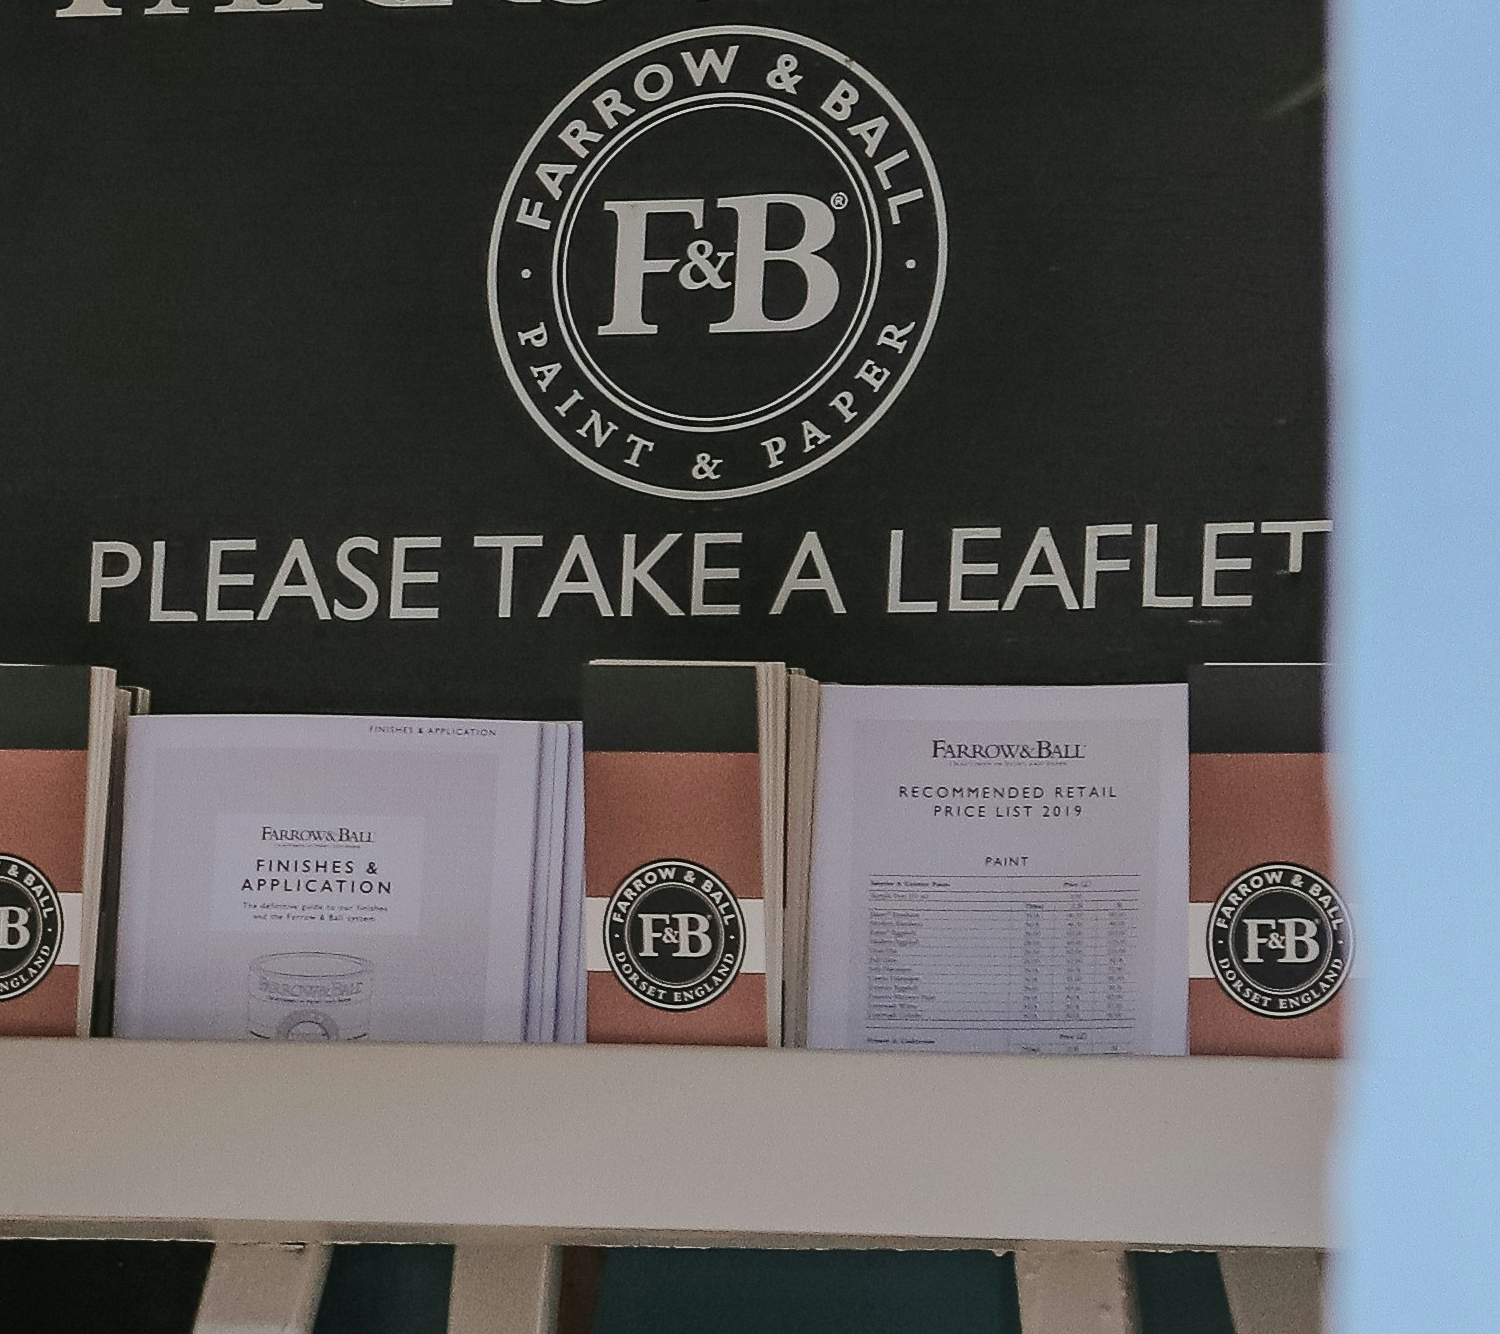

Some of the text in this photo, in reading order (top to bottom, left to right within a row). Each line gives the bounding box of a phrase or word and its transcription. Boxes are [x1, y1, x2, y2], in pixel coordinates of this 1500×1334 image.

[516, 45, 924, 229] FARROW & BALL
[518, 321, 915, 480] PAINT & PAPER
[89, 519, 1335, 622] PLEASE TAKE A LEAFLET
[427, 727, 497, 736] APPLICATION
[899, 785, 1118, 799] RECOMMENDED RETAIL
[933, 805, 1083, 818] PRICE LIST 2019
[240, 878, 392, 894] APPLICATION
[256, 859, 378, 875] FINISHES &
[985, 856, 1030, 867] PAINT
[7, 864, 20, 878] &
[23, 873, 55, 918] BALL
[612, 867, 736, 926] FARROW & BALL
[1216, 870, 1344, 930] FARROW & BALL
[616, 951, 735, 1002] DORSET ENGLAND
[1218, 957, 1344, 1009] DORSET ENGLAND
